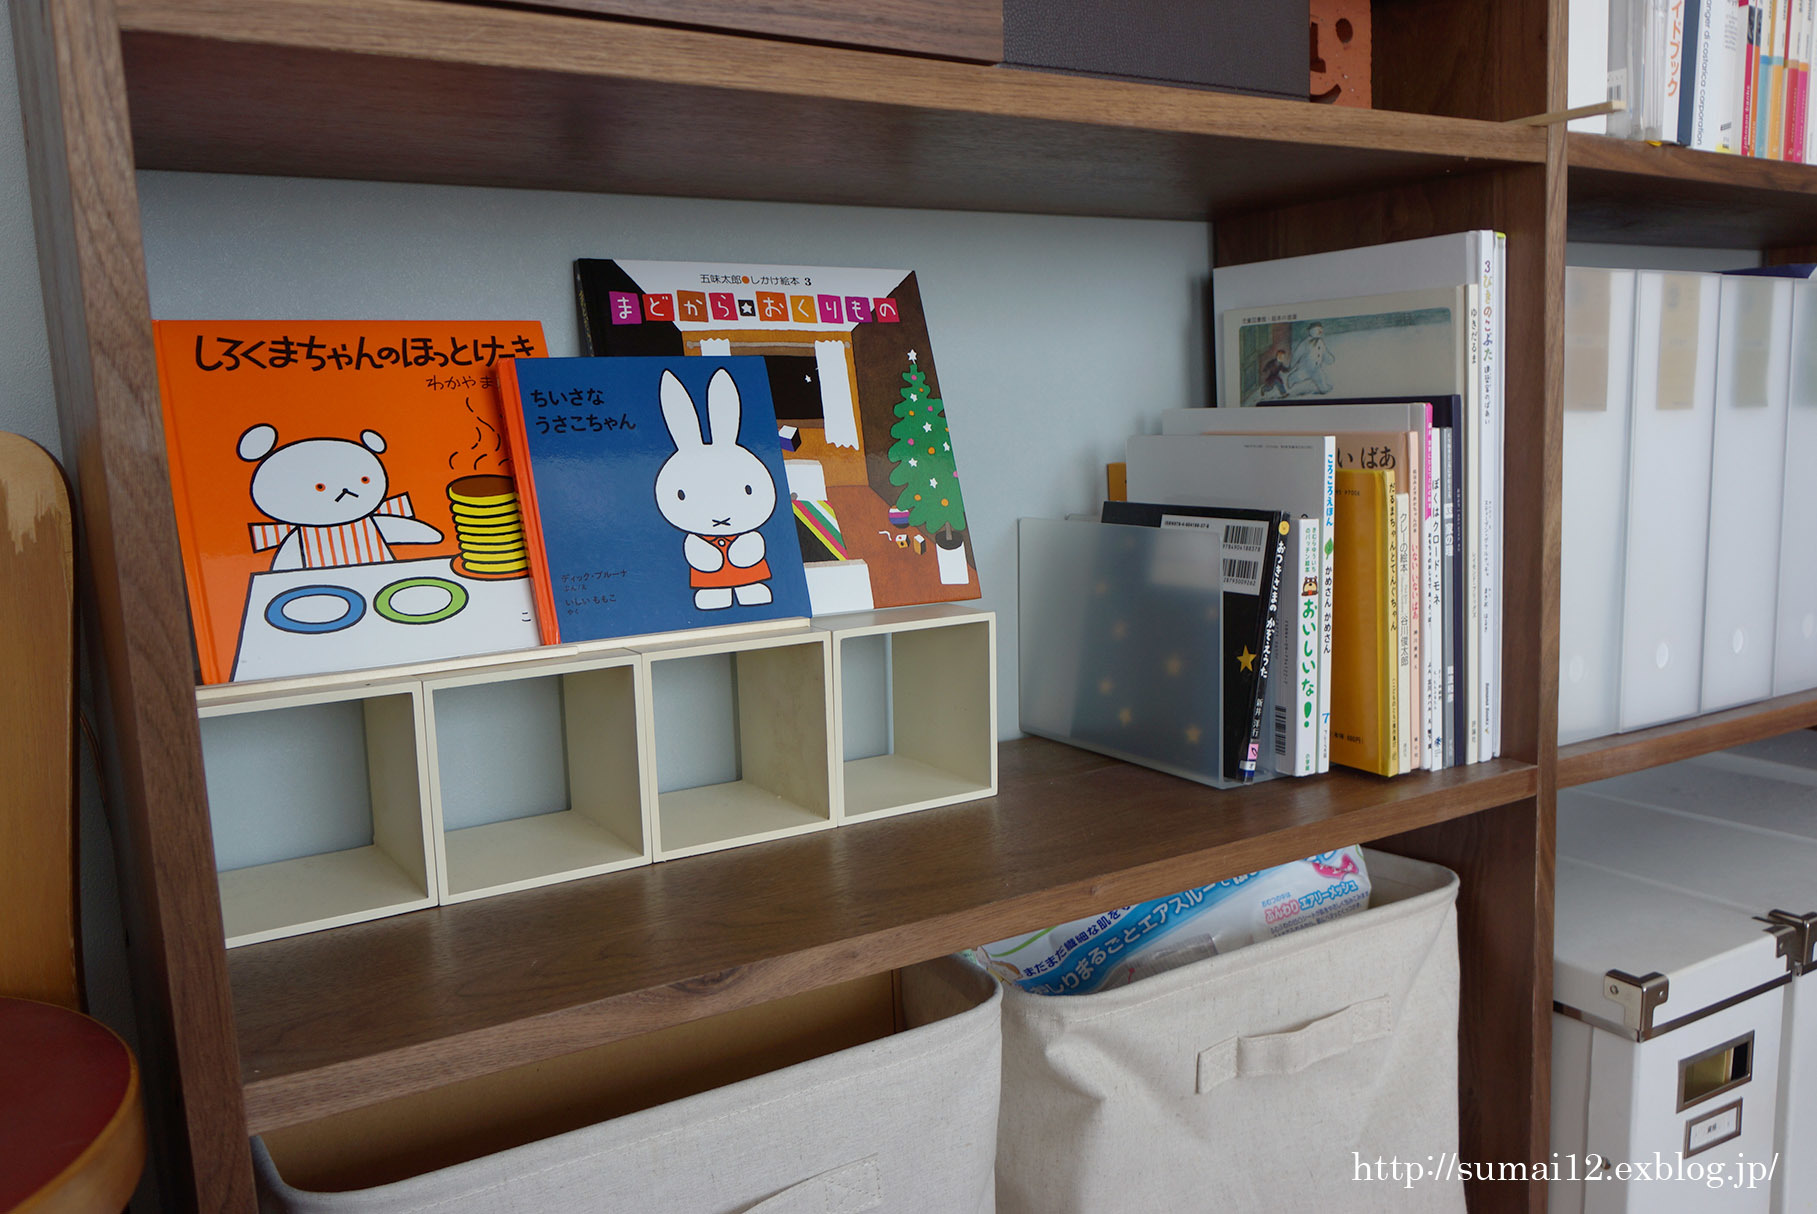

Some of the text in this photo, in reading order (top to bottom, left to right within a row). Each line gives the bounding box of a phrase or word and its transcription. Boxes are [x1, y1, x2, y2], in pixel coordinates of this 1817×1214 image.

[1700, 42, 1710, 89] costarica
[1697, 90, 1706, 146] corporation
[195, 334, 535, 372] しろくまちゃんのほっとけーき
[425, 376, 495, 391] わかやま
[530, 388, 605, 408] ちいさな
[535, 413, 637, 435] うさこちゃん
[1325, 454, 1334, 527] ころころえほん
[1388, 482, 1398, 632] だるまちゃんとてんぐちゃん
[1399, 513, 1409, 573] クレーの絵本
[1260, 617, 1276, 679] かぞえうた
[1023, 906, 1131, 977] まだまだ繊細な肌を
